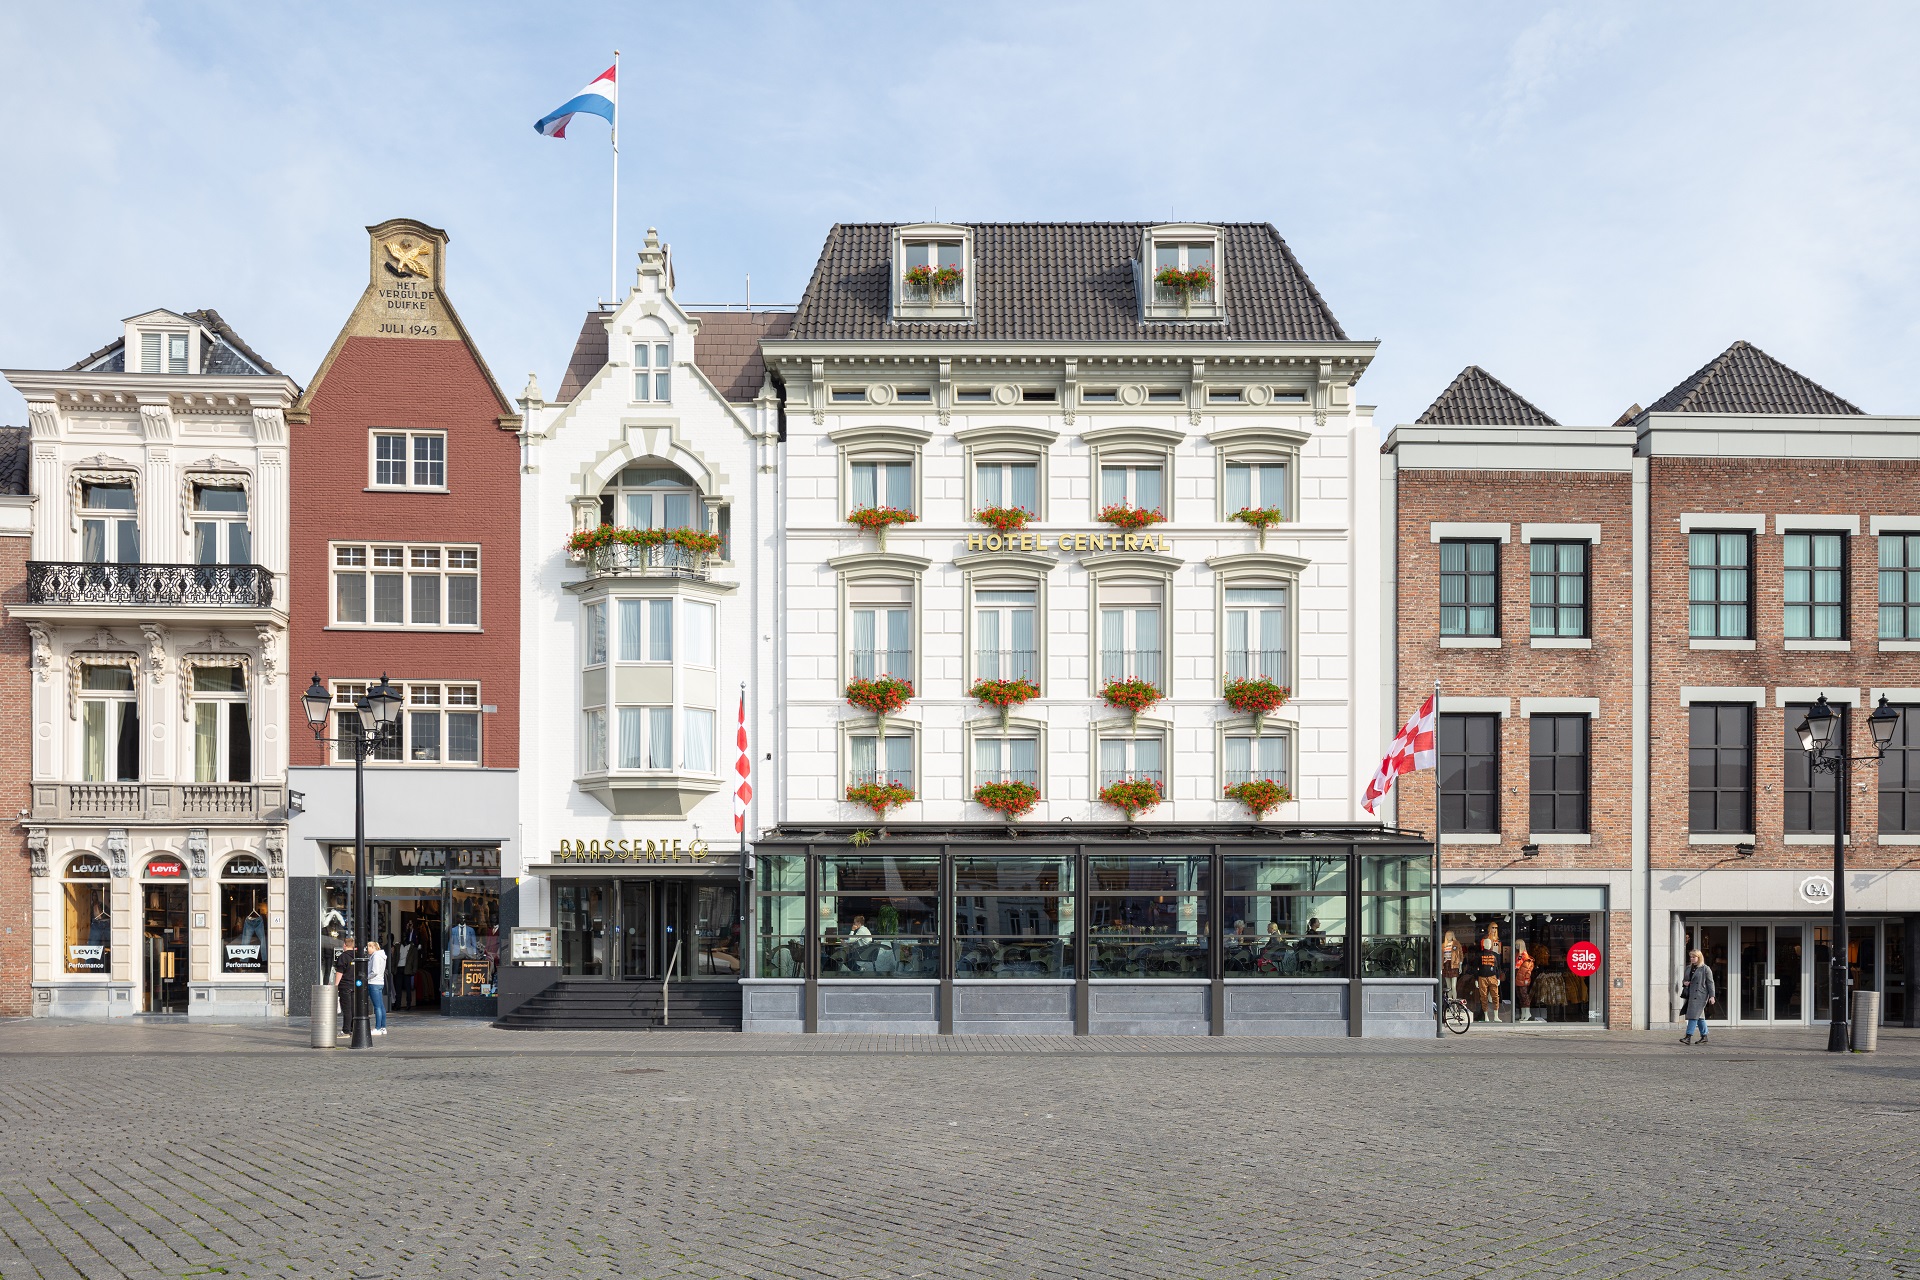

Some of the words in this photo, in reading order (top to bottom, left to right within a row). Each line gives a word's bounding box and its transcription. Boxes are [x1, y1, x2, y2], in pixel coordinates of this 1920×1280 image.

[396, 281, 417, 290] HET
[379, 290, 435, 300] VERGULDE
[387, 300, 427, 309] DUIFKE
[377, 323, 404, 334] JULI
[409, 325, 438, 336] 1945
[967, 533, 1048, 552] HOTEL
[1058, 533, 1171, 552] CENTRAL
[559, 839, 682, 860] BRASSERIE
[399, 850, 447, 867] WAM
[1804, 883, 1831, 897] C&A
[1571, 949, 1597, 962] sale
[68, 962, 105, 970] Performance
[465, 973, 486, 984] 50%
